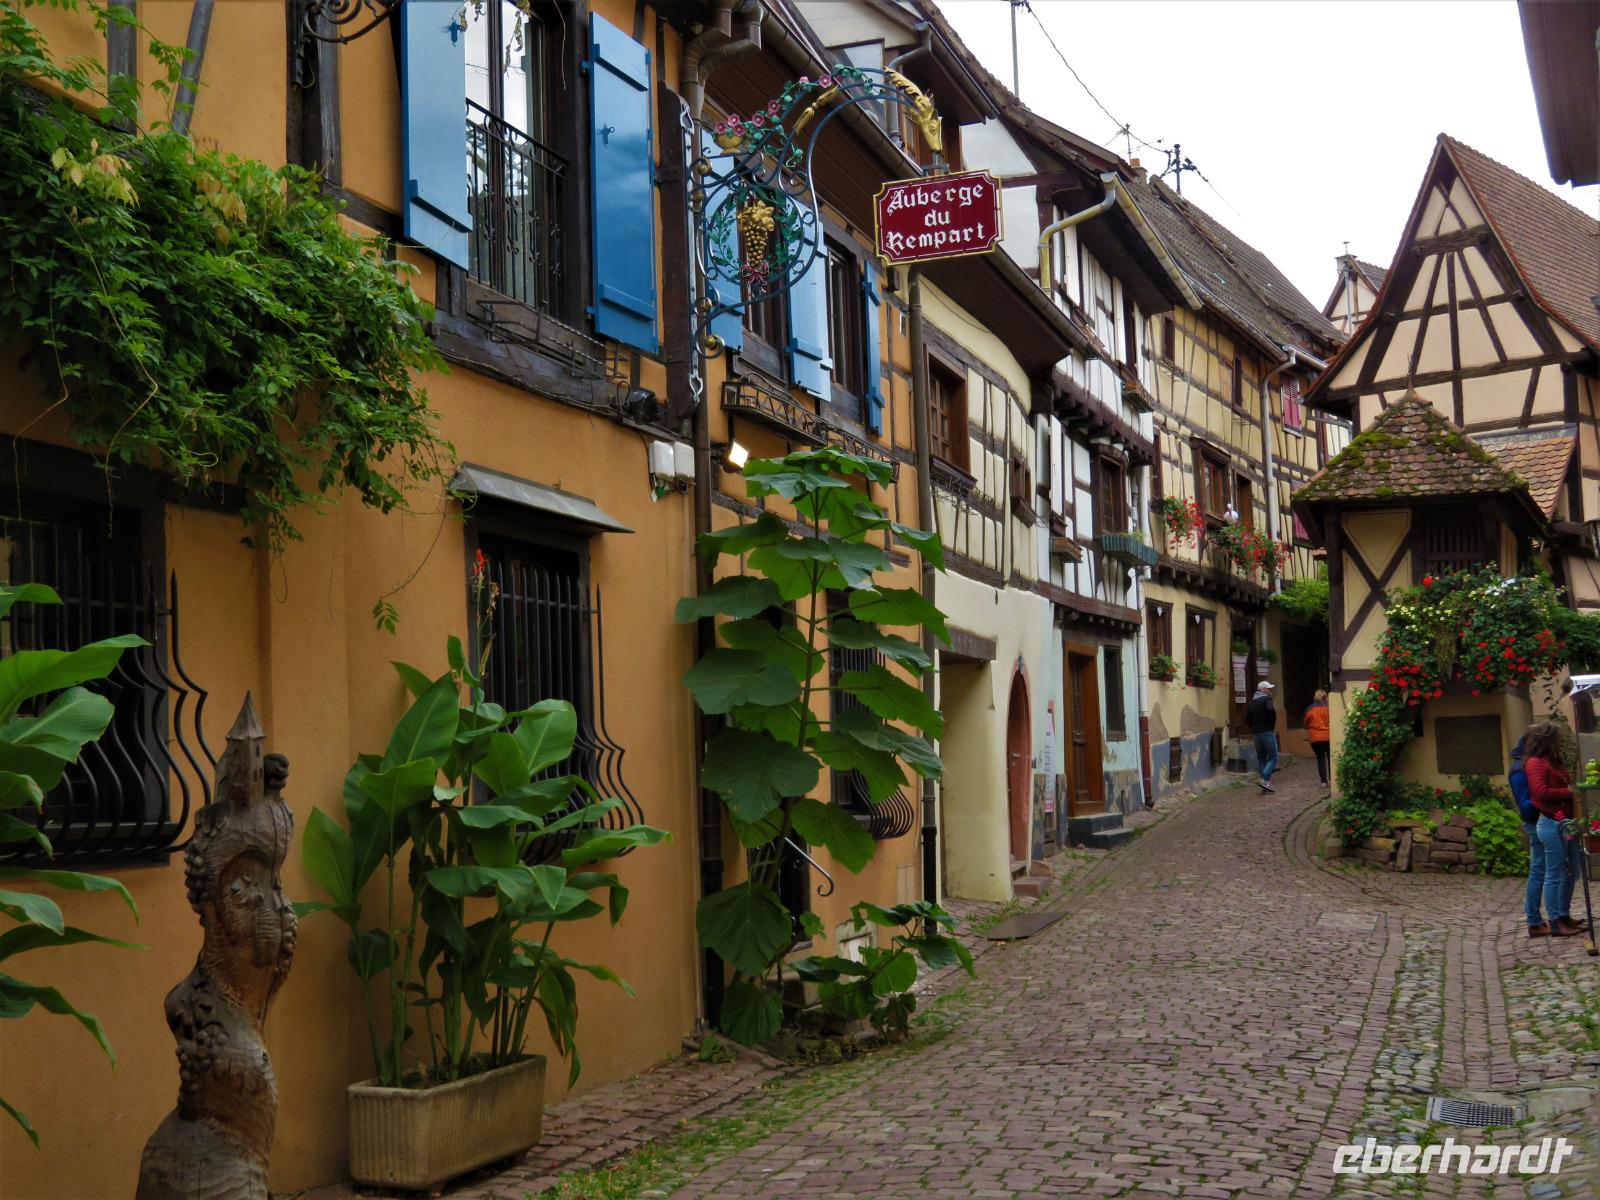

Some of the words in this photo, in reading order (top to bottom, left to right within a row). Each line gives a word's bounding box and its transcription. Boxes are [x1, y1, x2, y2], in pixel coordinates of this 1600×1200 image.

[887, 184, 984, 216] Auberge
[924, 208, 951, 227] du
[886, 222, 986, 256] Rempart
